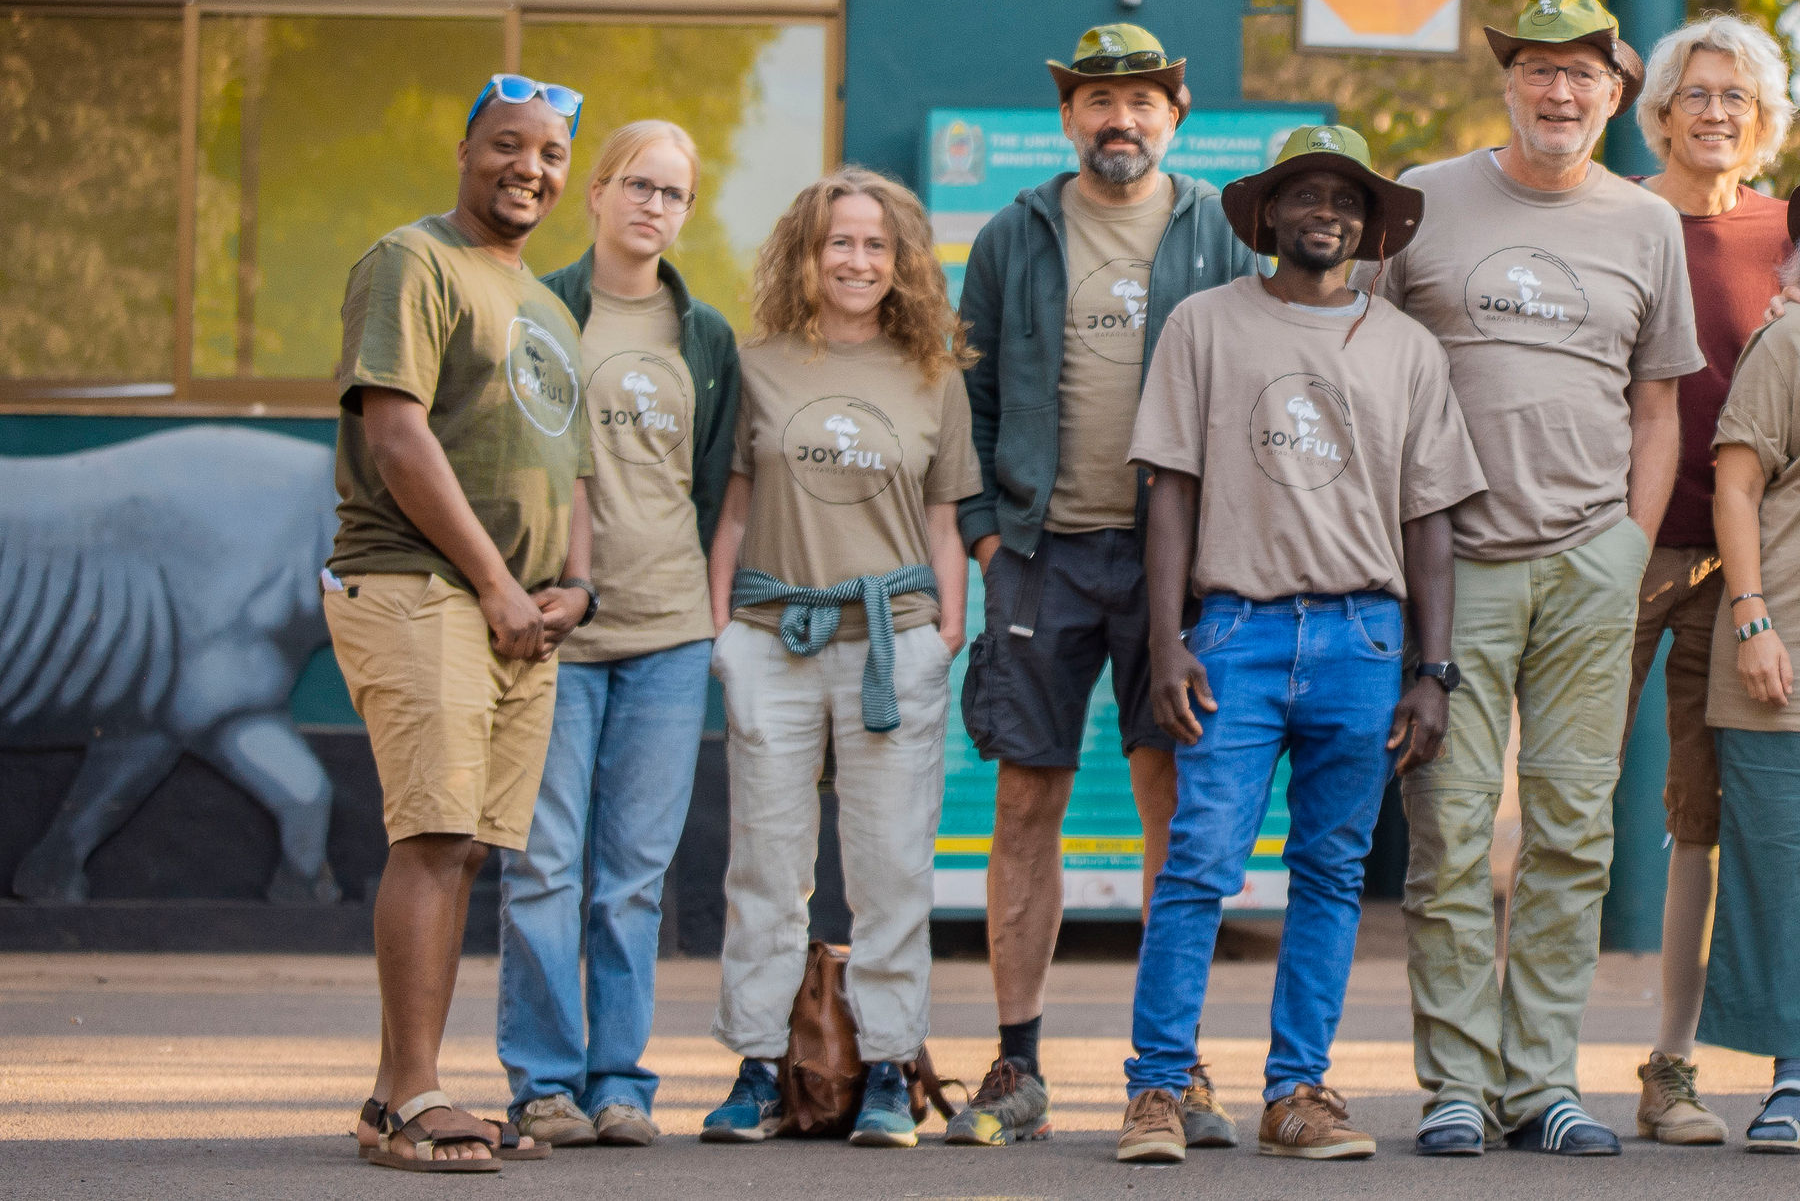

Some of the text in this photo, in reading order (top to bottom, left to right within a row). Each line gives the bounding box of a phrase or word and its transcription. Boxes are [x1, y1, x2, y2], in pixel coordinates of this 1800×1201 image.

[1311, 141, 1340, 151] JOYFUL
[1480, 294, 1570, 322] JOYFUL
[1087, 313, 1146, 330] JOYF
[518, 366, 566, 404] JOYFUL
[600, 409, 679, 433] JOYFUL
[796, 445, 887, 471] JOYFUL
[1261, 430, 1342, 462] JOYFUL
